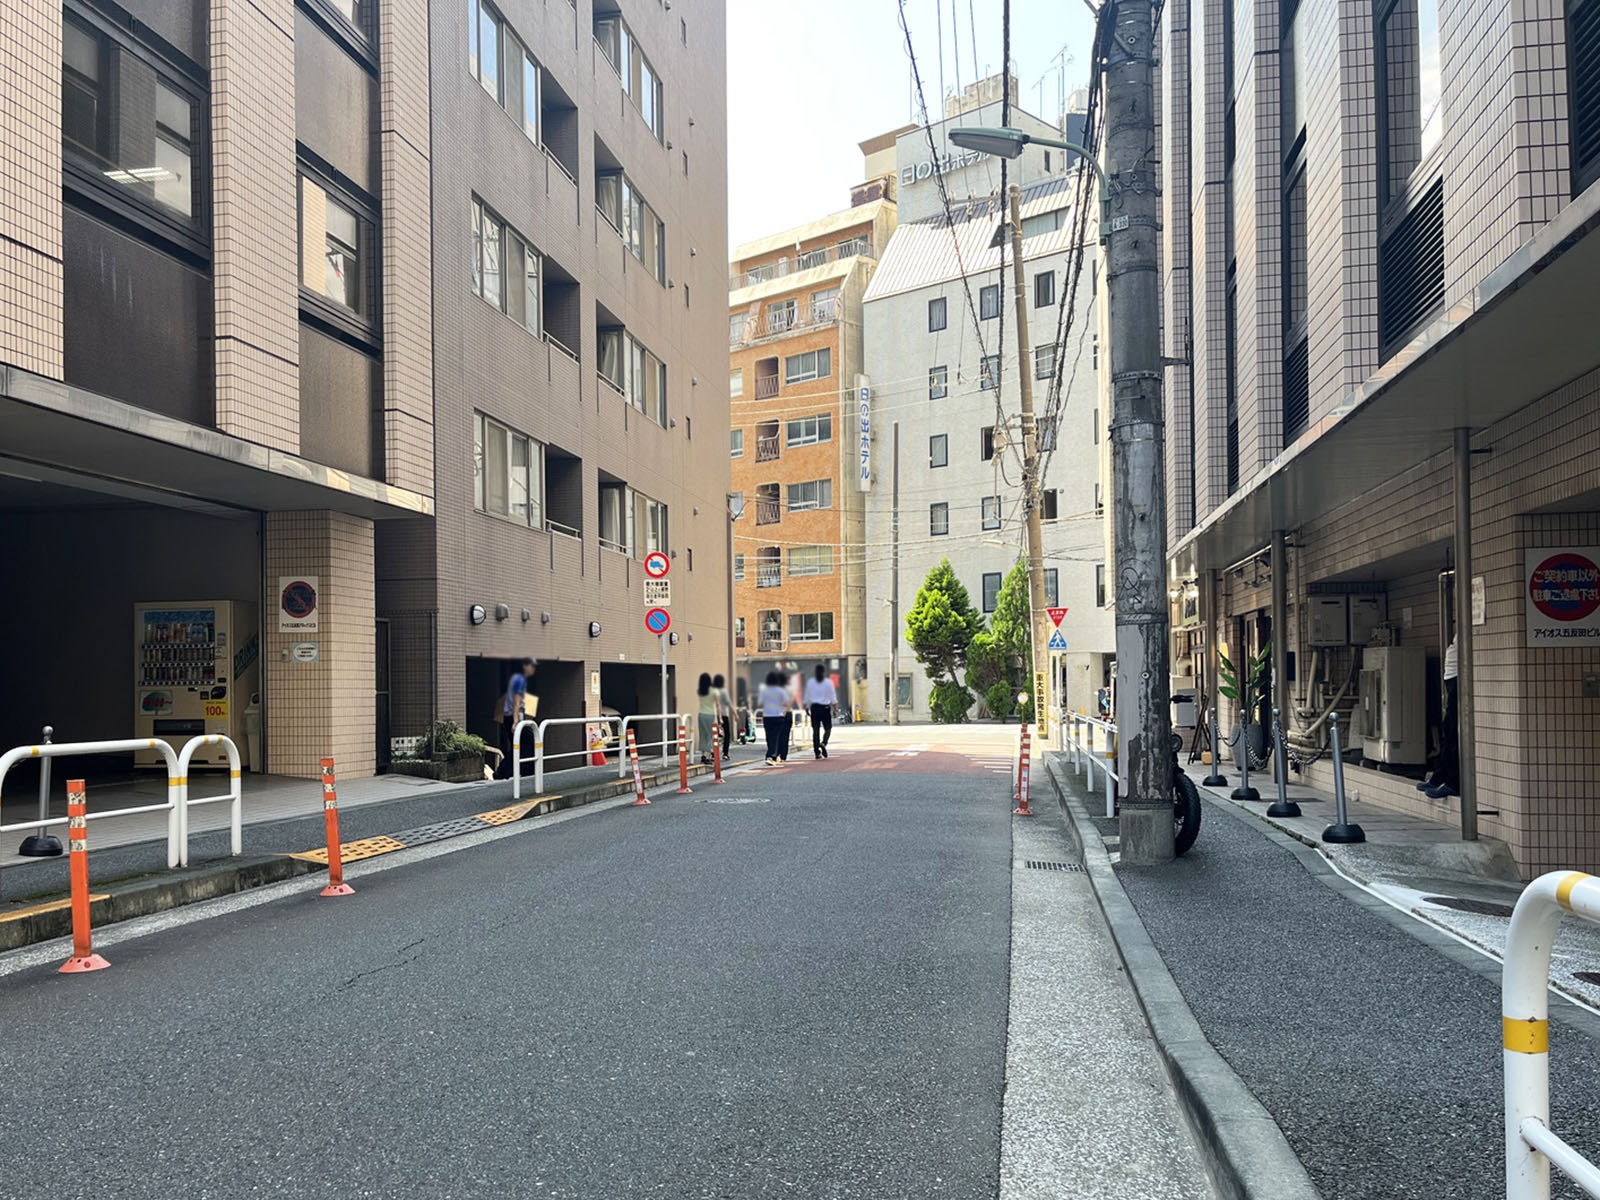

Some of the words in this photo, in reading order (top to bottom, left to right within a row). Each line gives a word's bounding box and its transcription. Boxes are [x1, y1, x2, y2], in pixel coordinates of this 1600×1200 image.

[901, 151, 990, 186] 日の出ホテル
[860, 387, 870, 479] 日の出ホテル
